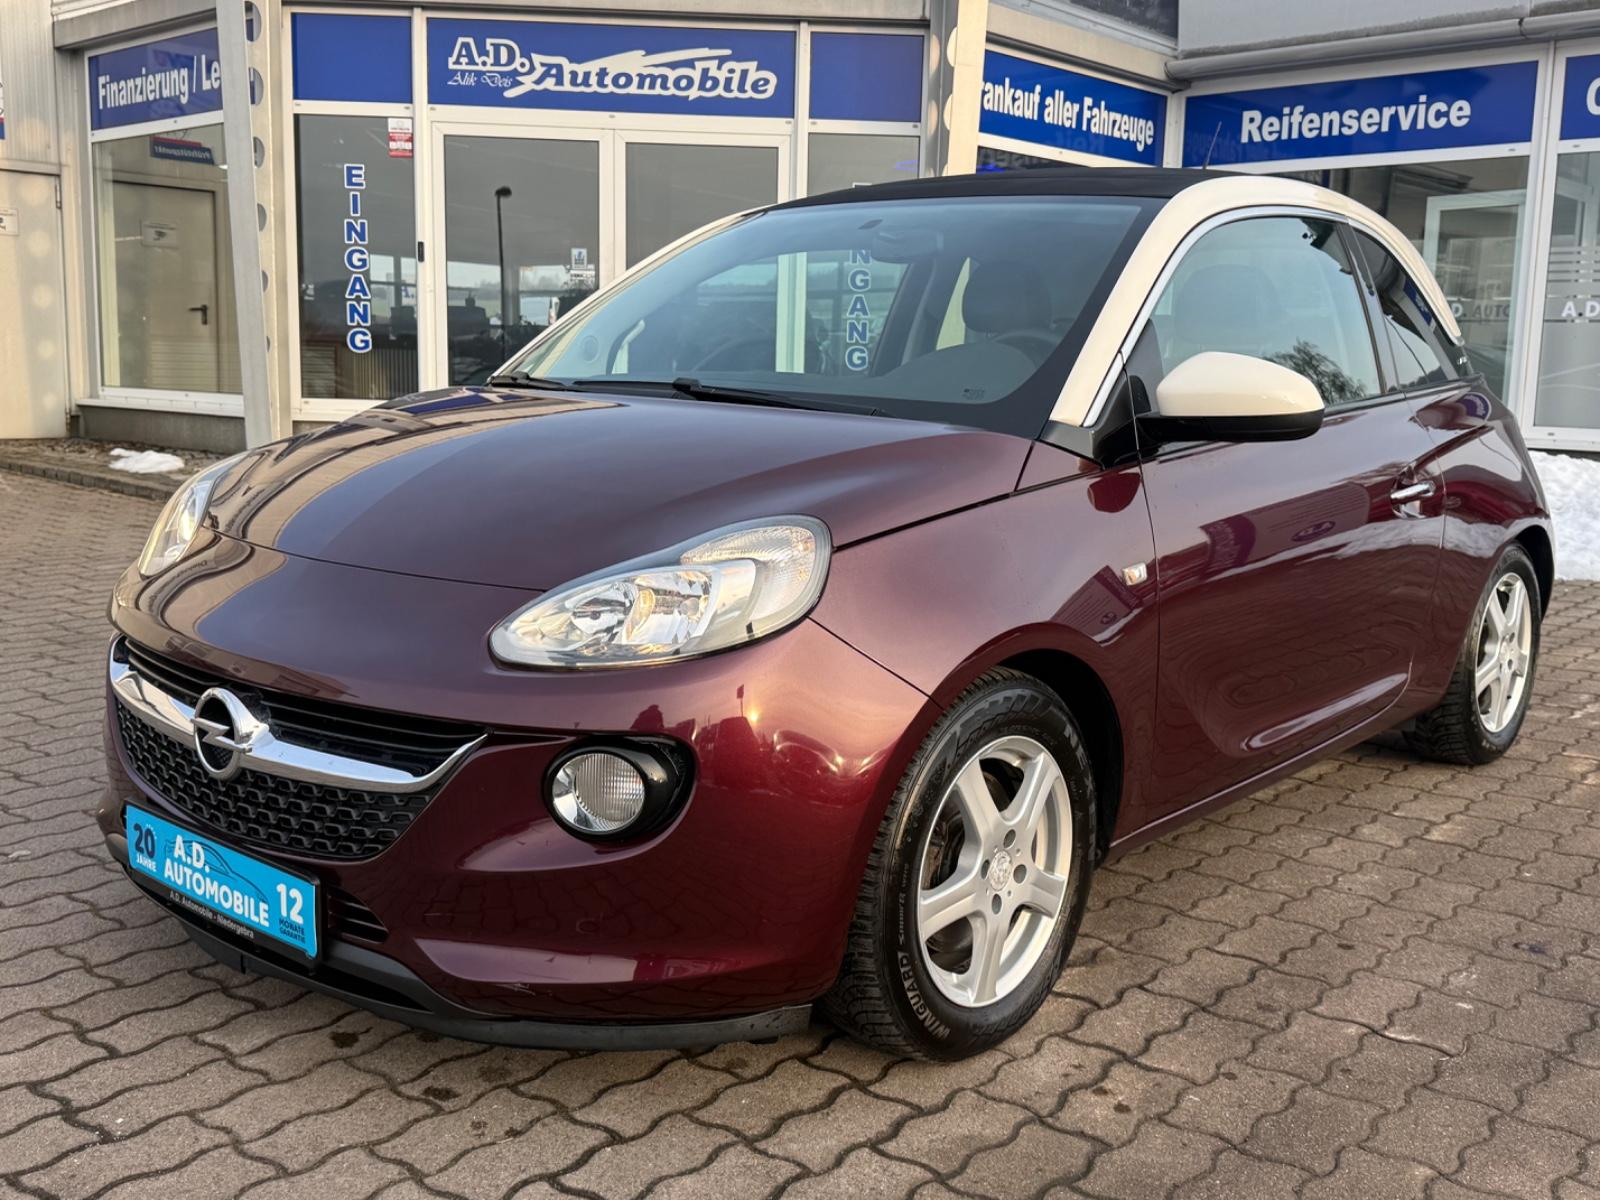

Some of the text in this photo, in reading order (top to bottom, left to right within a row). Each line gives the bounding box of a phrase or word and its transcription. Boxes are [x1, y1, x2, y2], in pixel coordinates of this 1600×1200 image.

[97, 67, 188, 109] Finanzierung
[449, 37, 774, 98] A.D. Automobile
[1044, 89, 1079, 129] aller
[1082, 97, 1155, 152] Fahrzeuge
[1240, 95, 1471, 143] Reifenservice
[344, 164, 372, 353] EINGANG
[134, 823, 155, 858] 20
[174, 834, 210, 873] A.D.
[164, 857, 270, 927] AUTOMOBILE
[276, 883, 304, 925] 12
[897, 951, 950, 1040] WINGUARD
